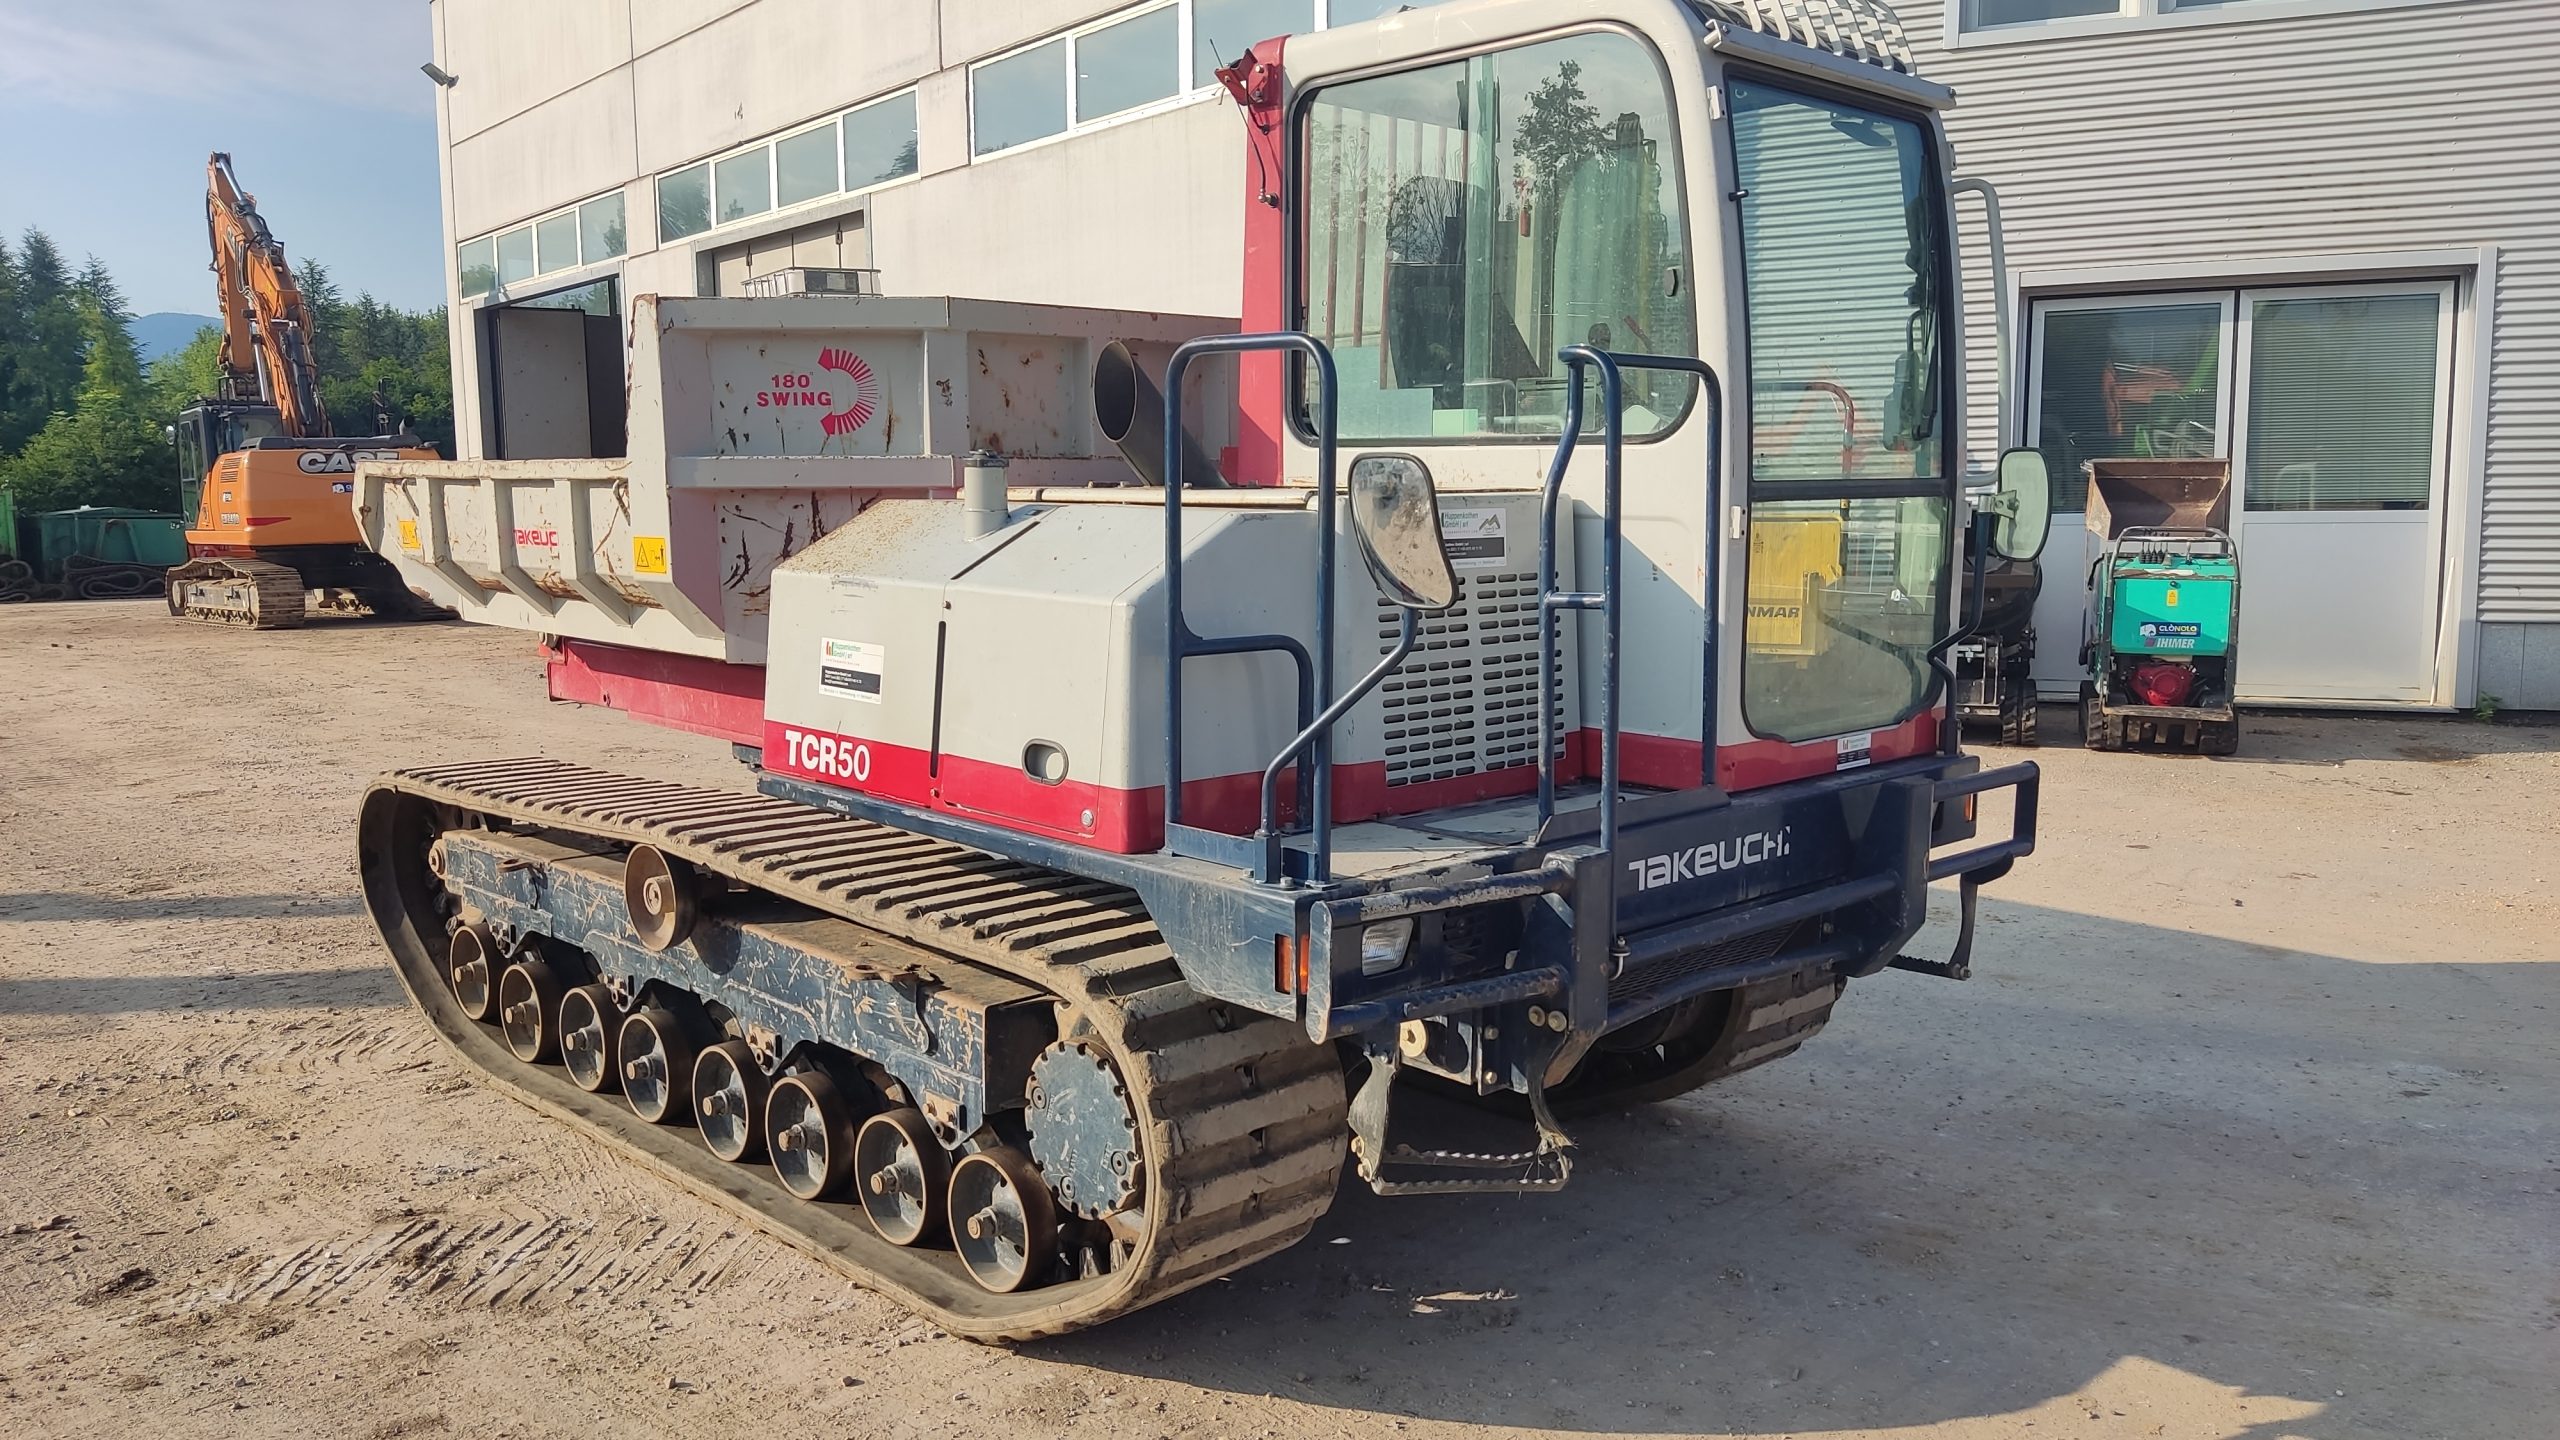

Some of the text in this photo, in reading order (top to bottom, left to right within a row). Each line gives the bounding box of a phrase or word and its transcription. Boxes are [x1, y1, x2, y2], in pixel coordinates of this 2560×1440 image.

[756, 391, 832, 407] SWING
[2156, 638, 2195, 649] IHIMER
[785, 729, 871, 782] TCR50
